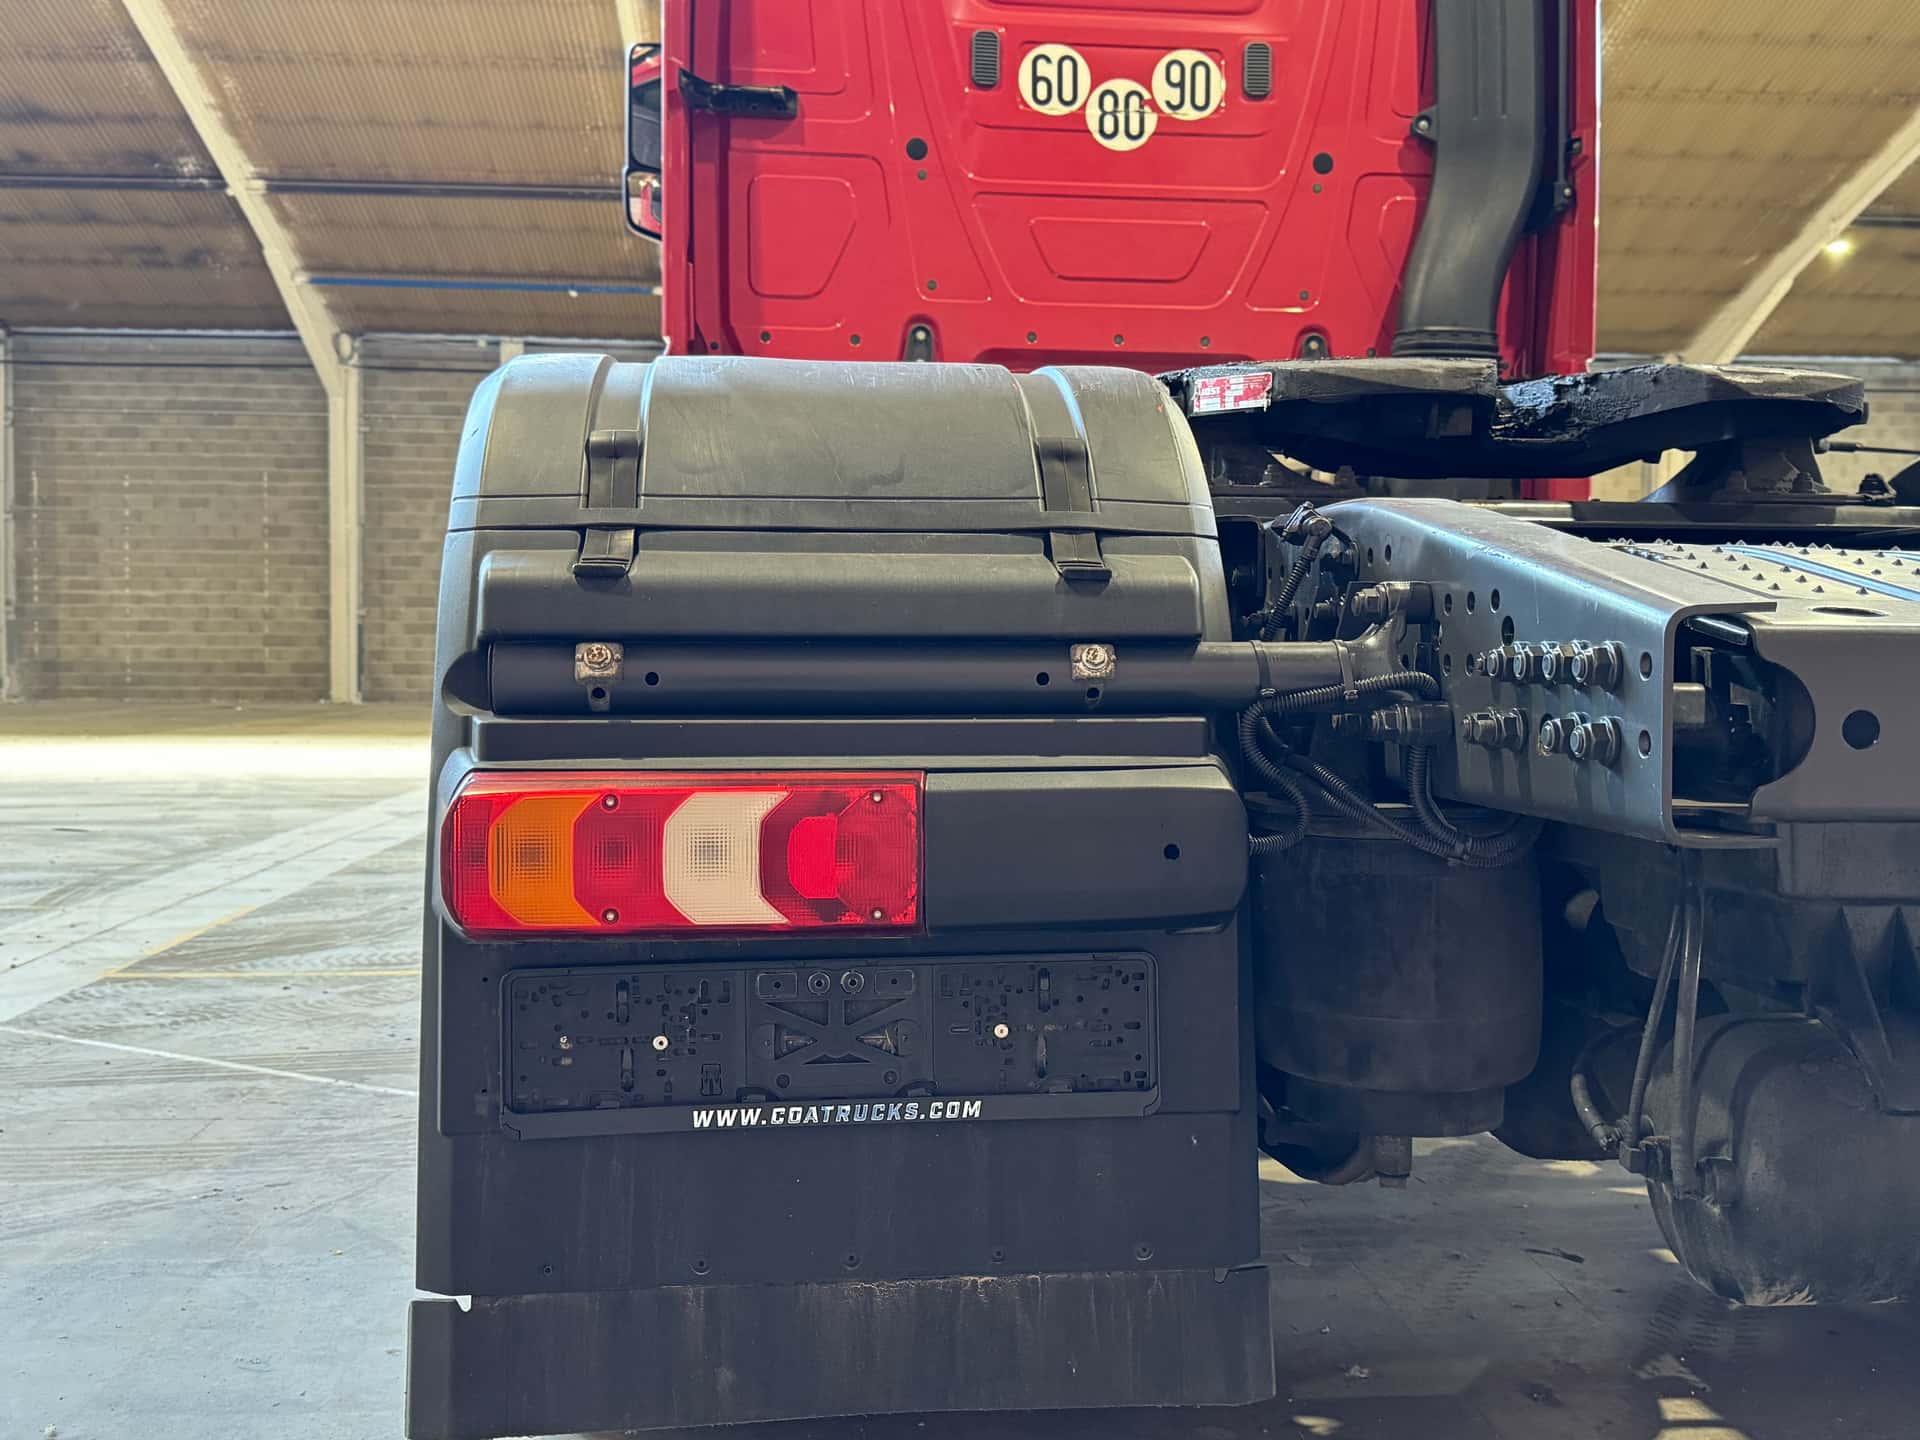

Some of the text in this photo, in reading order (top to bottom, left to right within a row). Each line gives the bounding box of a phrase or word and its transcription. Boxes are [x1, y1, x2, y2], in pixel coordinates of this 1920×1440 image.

[1031, 54, 1078, 107] 60
[1165, 59, 1211, 112] 90
[1099, 89, 1146, 141] 80
